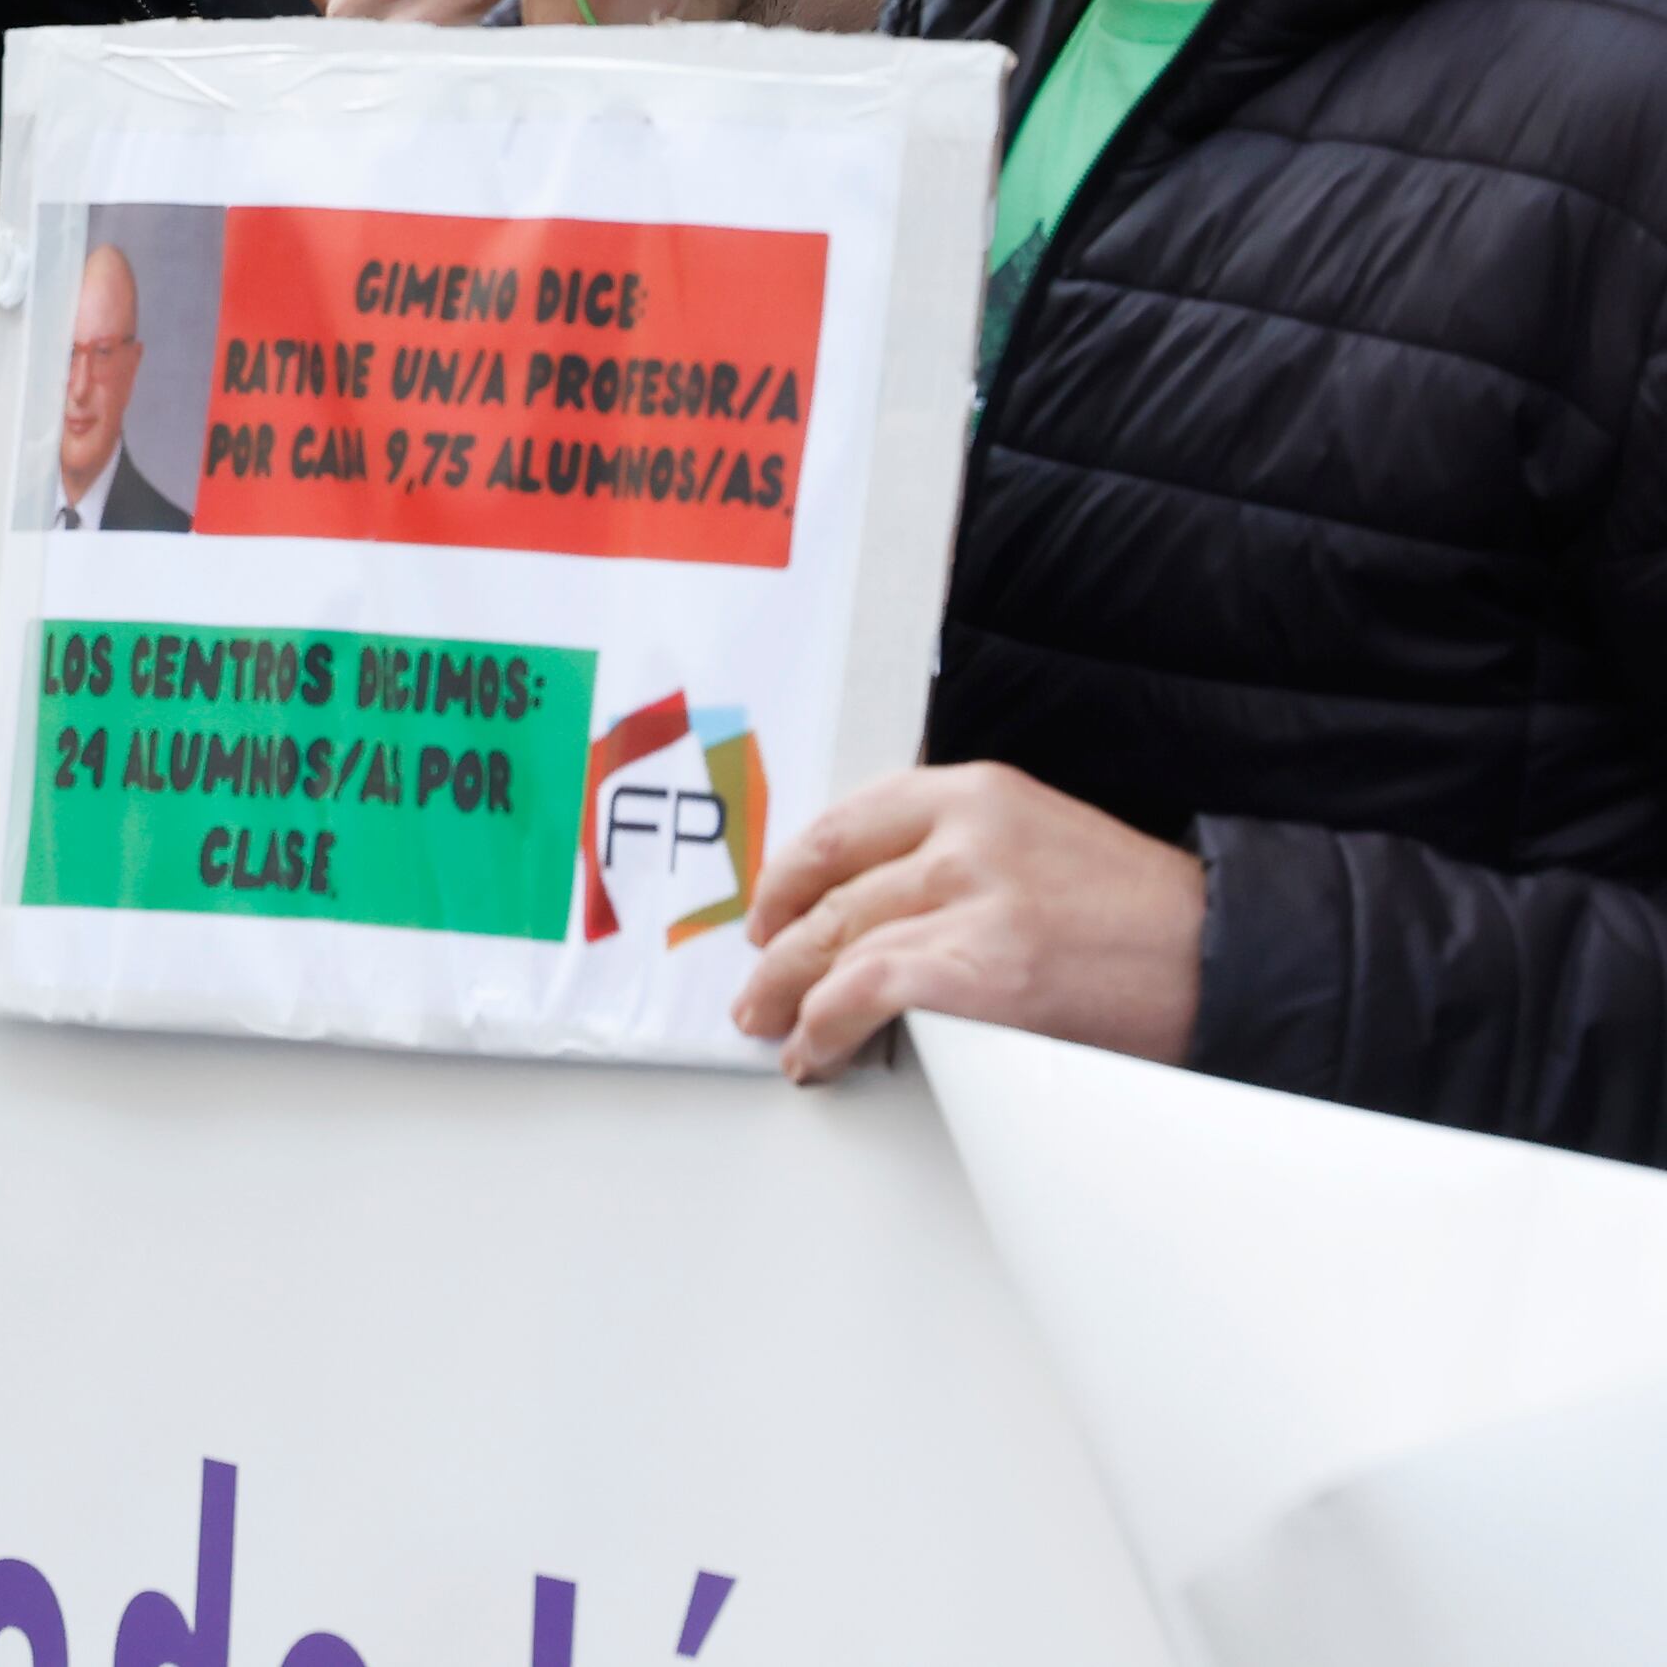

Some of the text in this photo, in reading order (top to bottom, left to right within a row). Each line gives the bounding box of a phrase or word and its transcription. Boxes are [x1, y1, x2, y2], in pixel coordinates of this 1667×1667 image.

[356, 260, 519, 323] GIMENO
[224, 338, 325, 397] RATIO
[392, 346, 505, 405] UN/A
[525, 352, 800, 424] PROFESOR/A
[207, 423, 276, 478] POR
[386, 428, 476, 496] 9,75
[131, 635, 333, 707] CENTROS
[55, 726, 108, 789] 24
[416, 745, 511, 813] POR
[606, 785, 727, 874] FP
